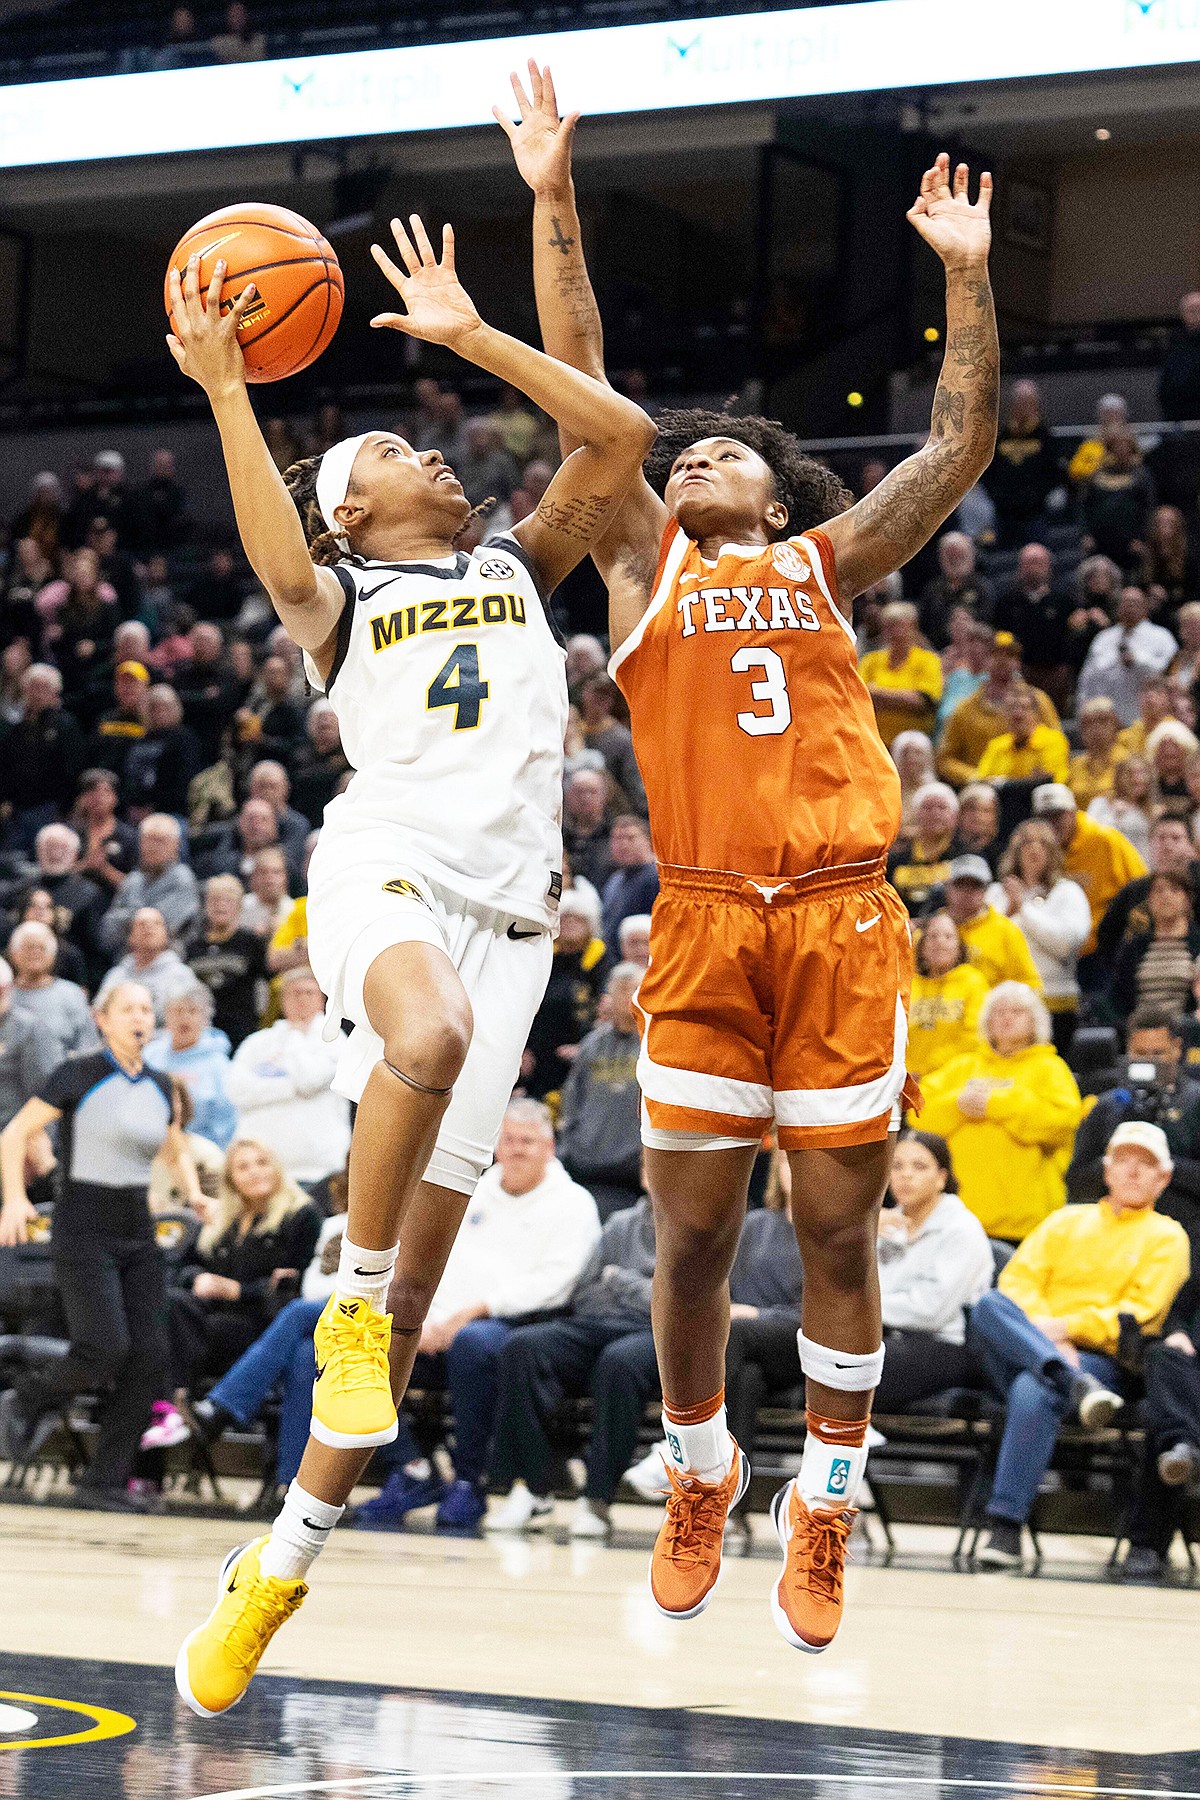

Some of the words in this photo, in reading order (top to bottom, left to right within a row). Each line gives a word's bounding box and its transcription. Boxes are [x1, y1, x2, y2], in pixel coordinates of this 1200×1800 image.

[663, 22, 841, 82] Multipli
[368, 593, 526, 654] MIZZOU
[677, 587, 821, 639] TEXAS
[426, 642, 490, 732] 4
[730, 646, 792, 737] 3
